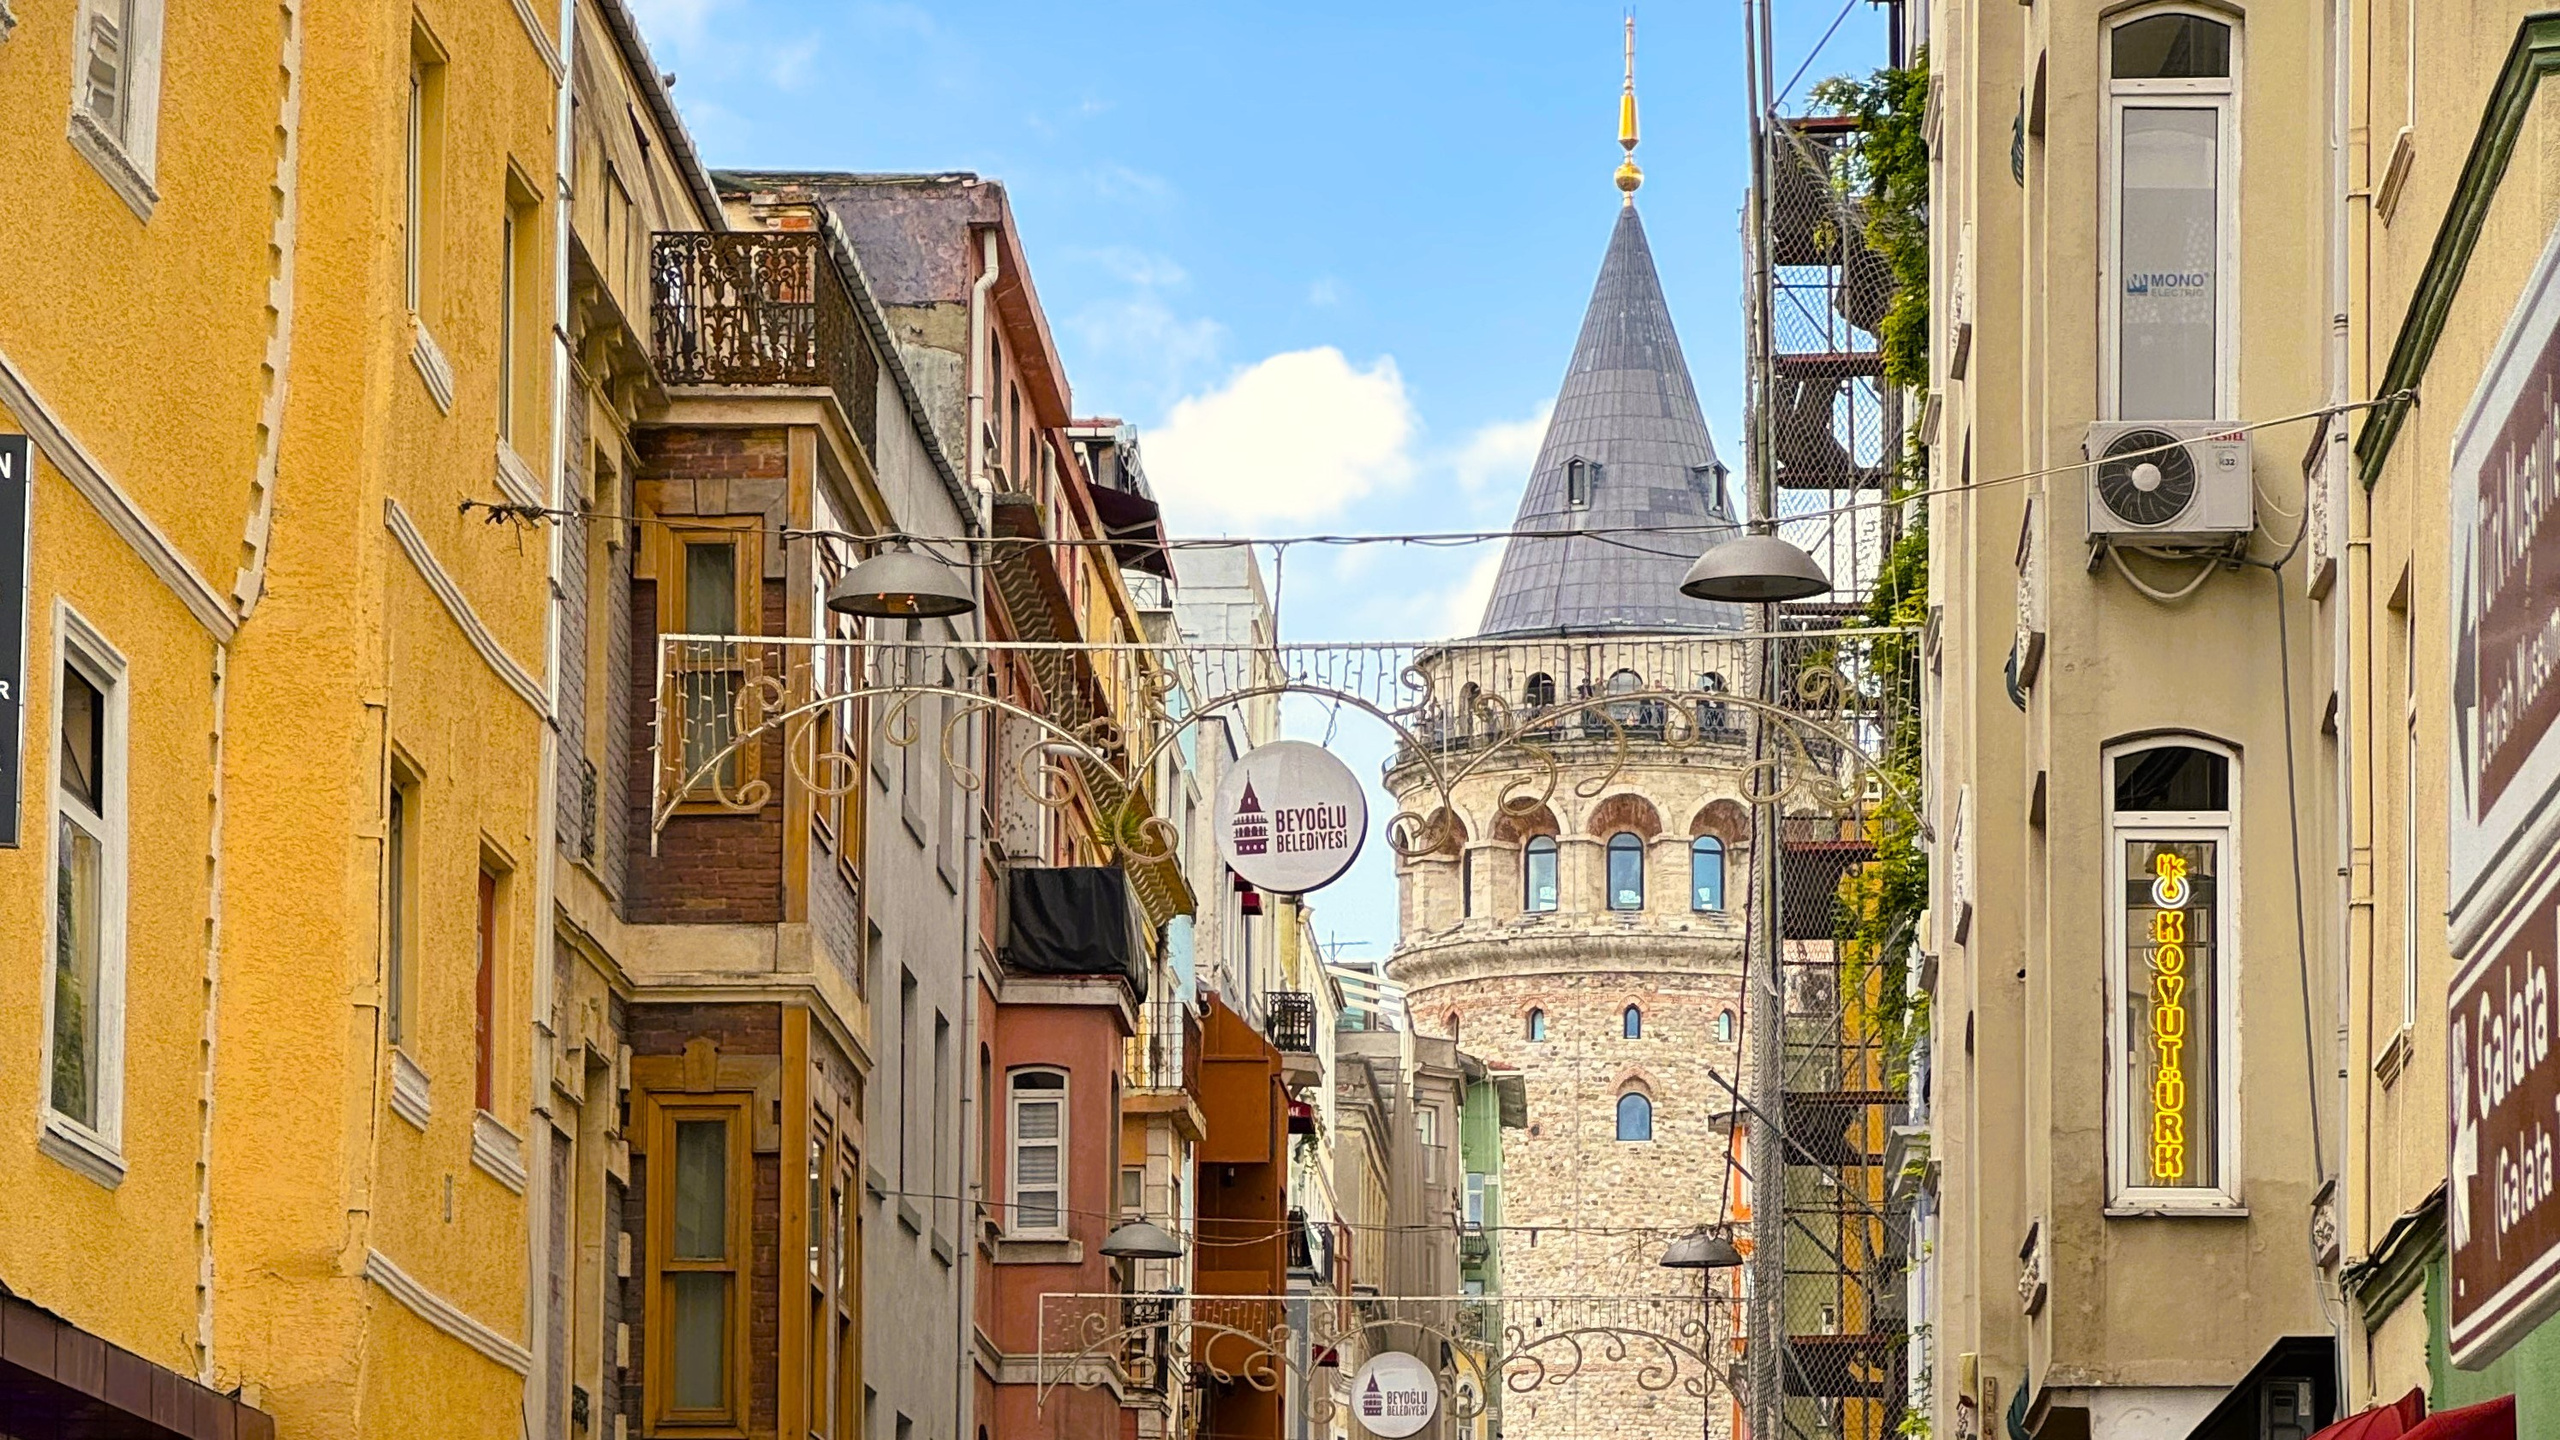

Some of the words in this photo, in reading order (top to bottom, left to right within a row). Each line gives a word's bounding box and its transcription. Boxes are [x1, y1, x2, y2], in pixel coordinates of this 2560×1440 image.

[2151, 273, 2205, 288] MONO
[1275, 802, 1347, 833] BEYOĞLU
[2155, 910, 2185, 1178] KOYUTÜRK
[2478, 950, 2549, 1121] Galata
[2495, 1121, 2552, 1262] (Galata
[1386, 1388, 1428, 1405] BEYOĞLU
